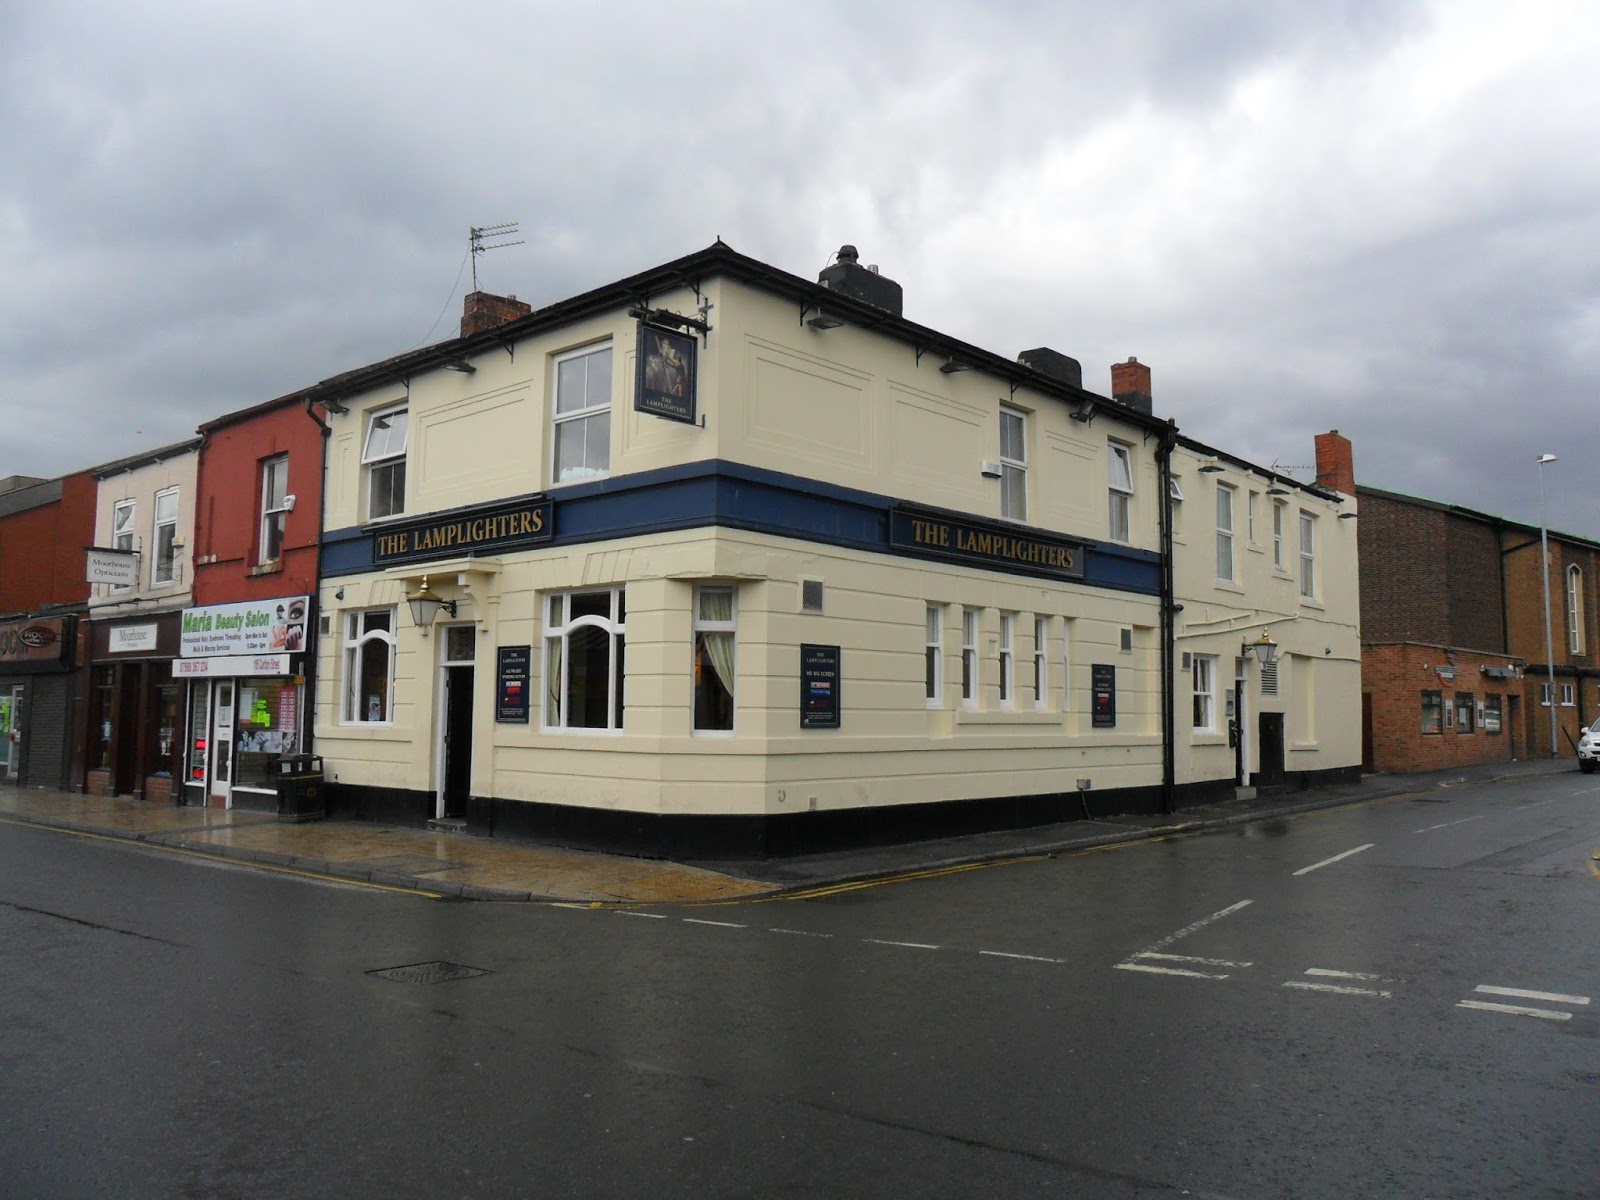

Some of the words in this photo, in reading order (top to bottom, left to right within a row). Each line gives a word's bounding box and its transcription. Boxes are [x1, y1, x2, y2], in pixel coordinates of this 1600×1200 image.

[646, 400, 686, 413] LAMPLIGHTERS
[378, 533, 408, 556] THE
[414, 509, 543, 551] LAMPLIGHTERS
[912, 520, 949, 546] THE
[956, 528, 1074, 568] LAMPLIGHTERS
[92, 559, 132, 568] Moorhouse
[94, 568, 128, 578] Opticians
[183, 611, 212, 633] Maria
[216, 612, 244, 632] Beauty
[245, 610, 270, 628] Salon
[120, 628, 147, 642] Moorhouse
